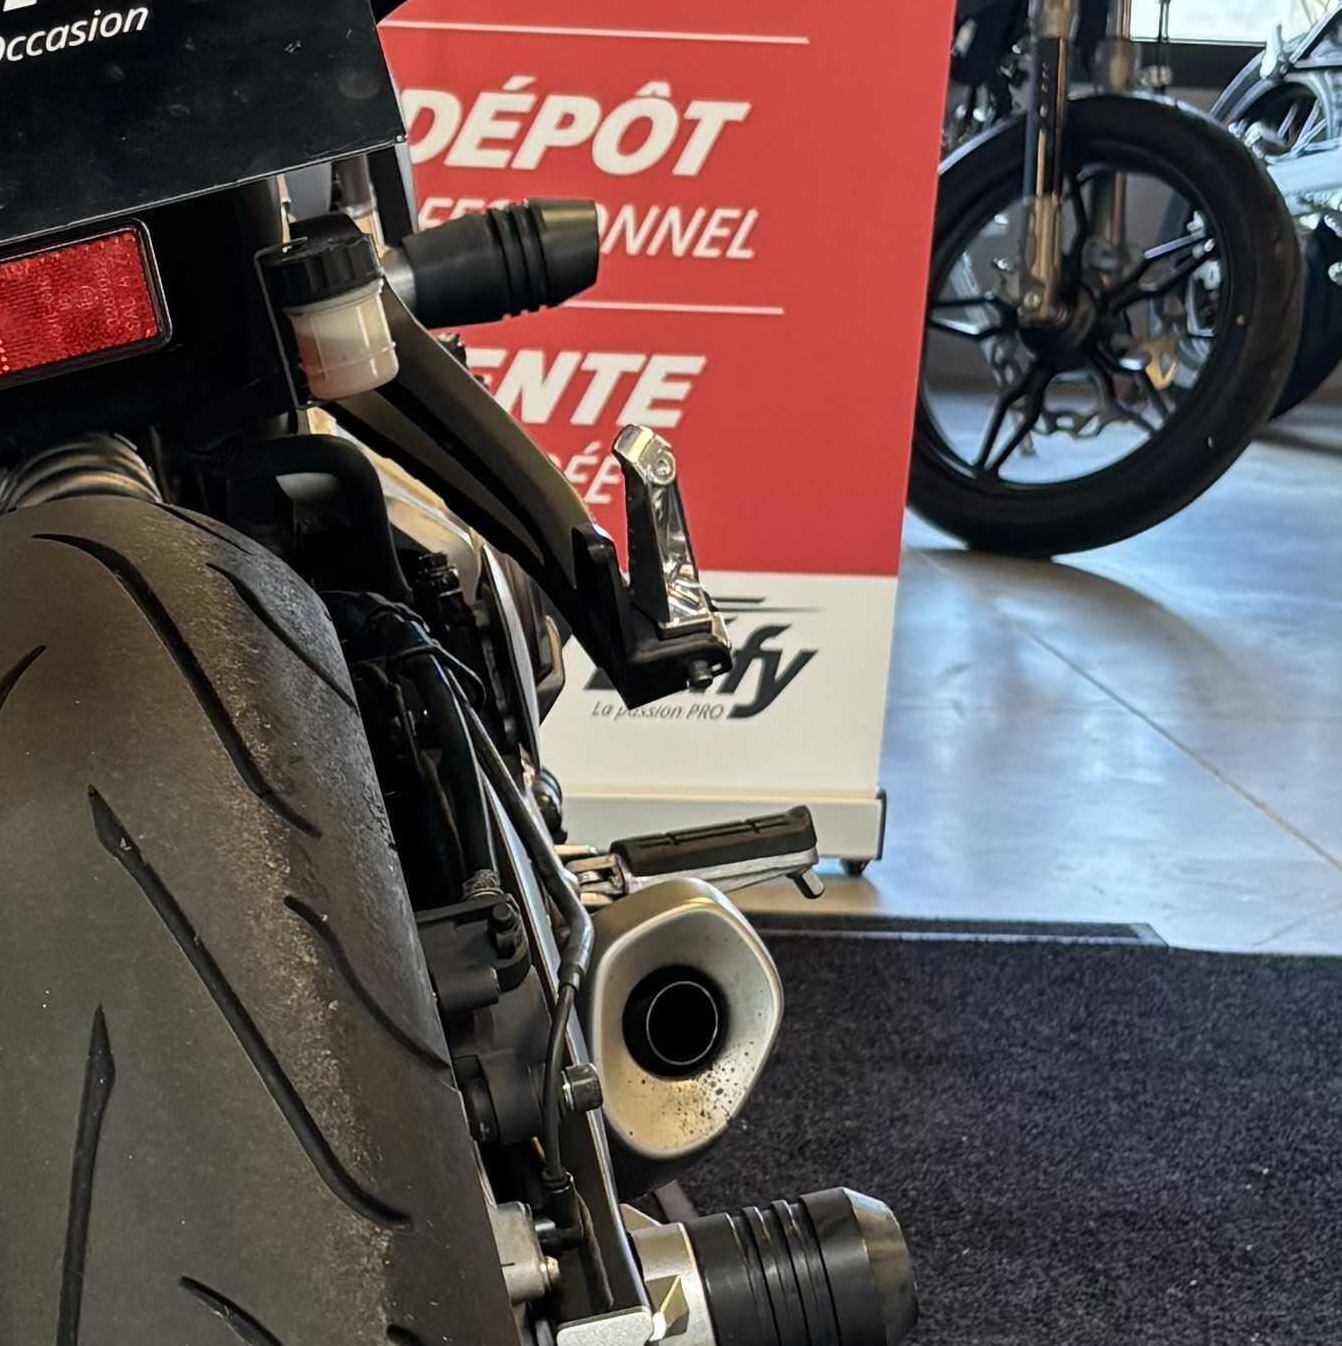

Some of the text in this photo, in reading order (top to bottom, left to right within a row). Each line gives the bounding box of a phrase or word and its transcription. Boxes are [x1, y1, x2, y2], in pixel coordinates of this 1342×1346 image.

[398, 74, 752, 176] DÉPÔT
[465, 349, 709, 429] ENTE
[591, 700, 612, 719] La
[686, 703, 725, 721] PRO
